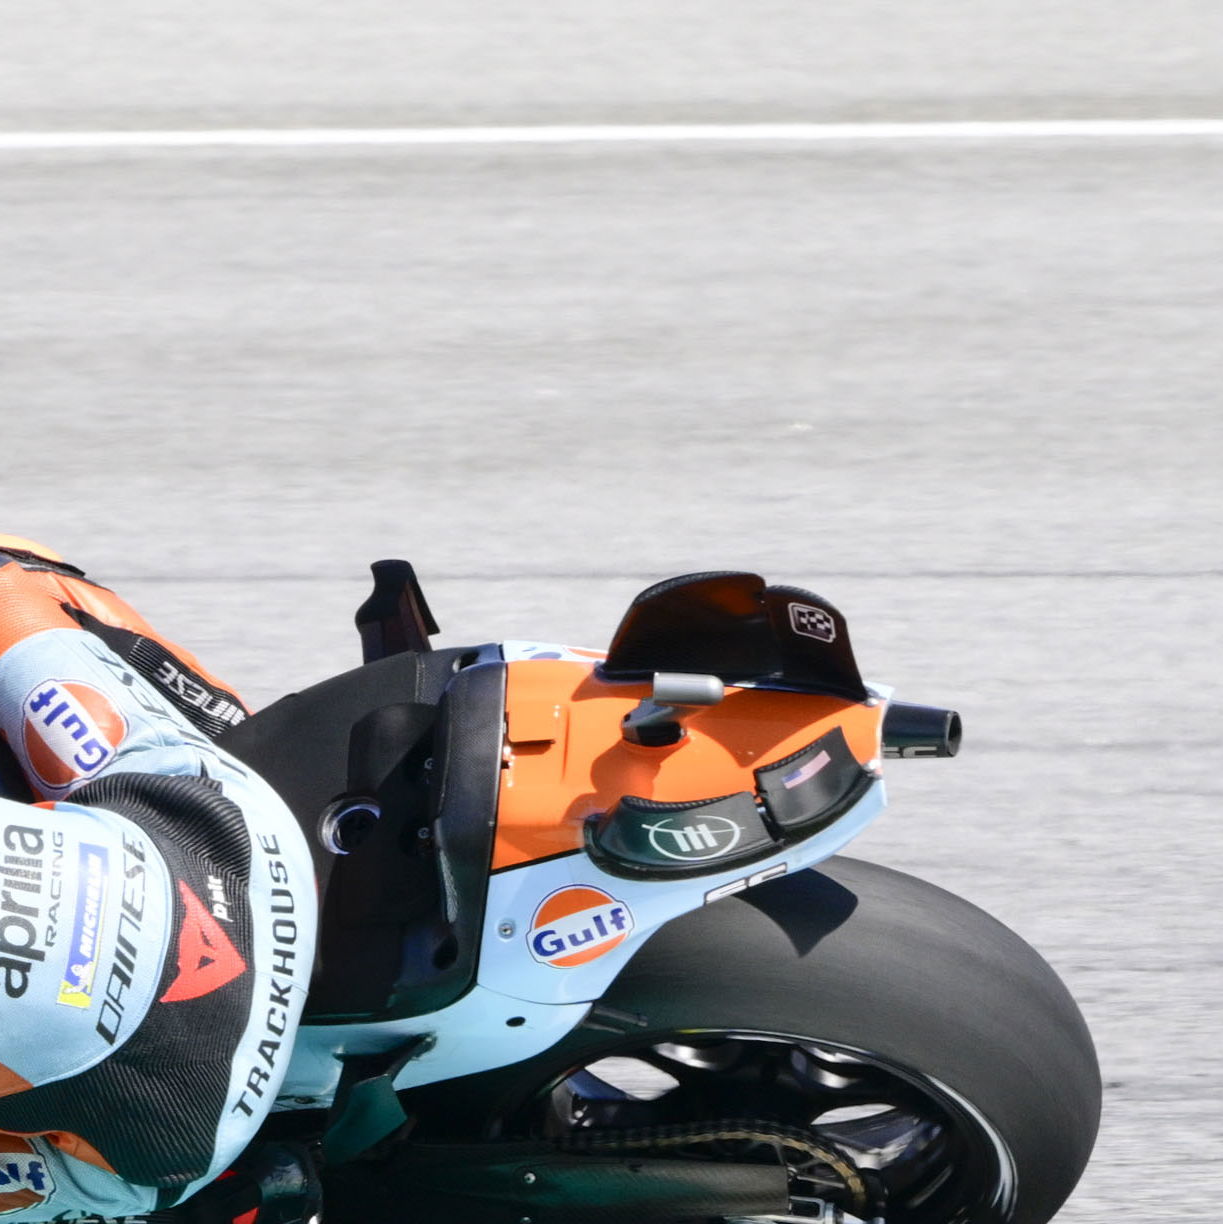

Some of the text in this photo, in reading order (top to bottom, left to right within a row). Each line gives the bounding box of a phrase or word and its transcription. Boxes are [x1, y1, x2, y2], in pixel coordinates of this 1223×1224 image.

[30, 687, 109, 772] Gulf
[45, 831, 64, 947] RACING
[533, 907, 626, 957] Gulf
[232, 834, 297, 1118] TRACKHOUSE
